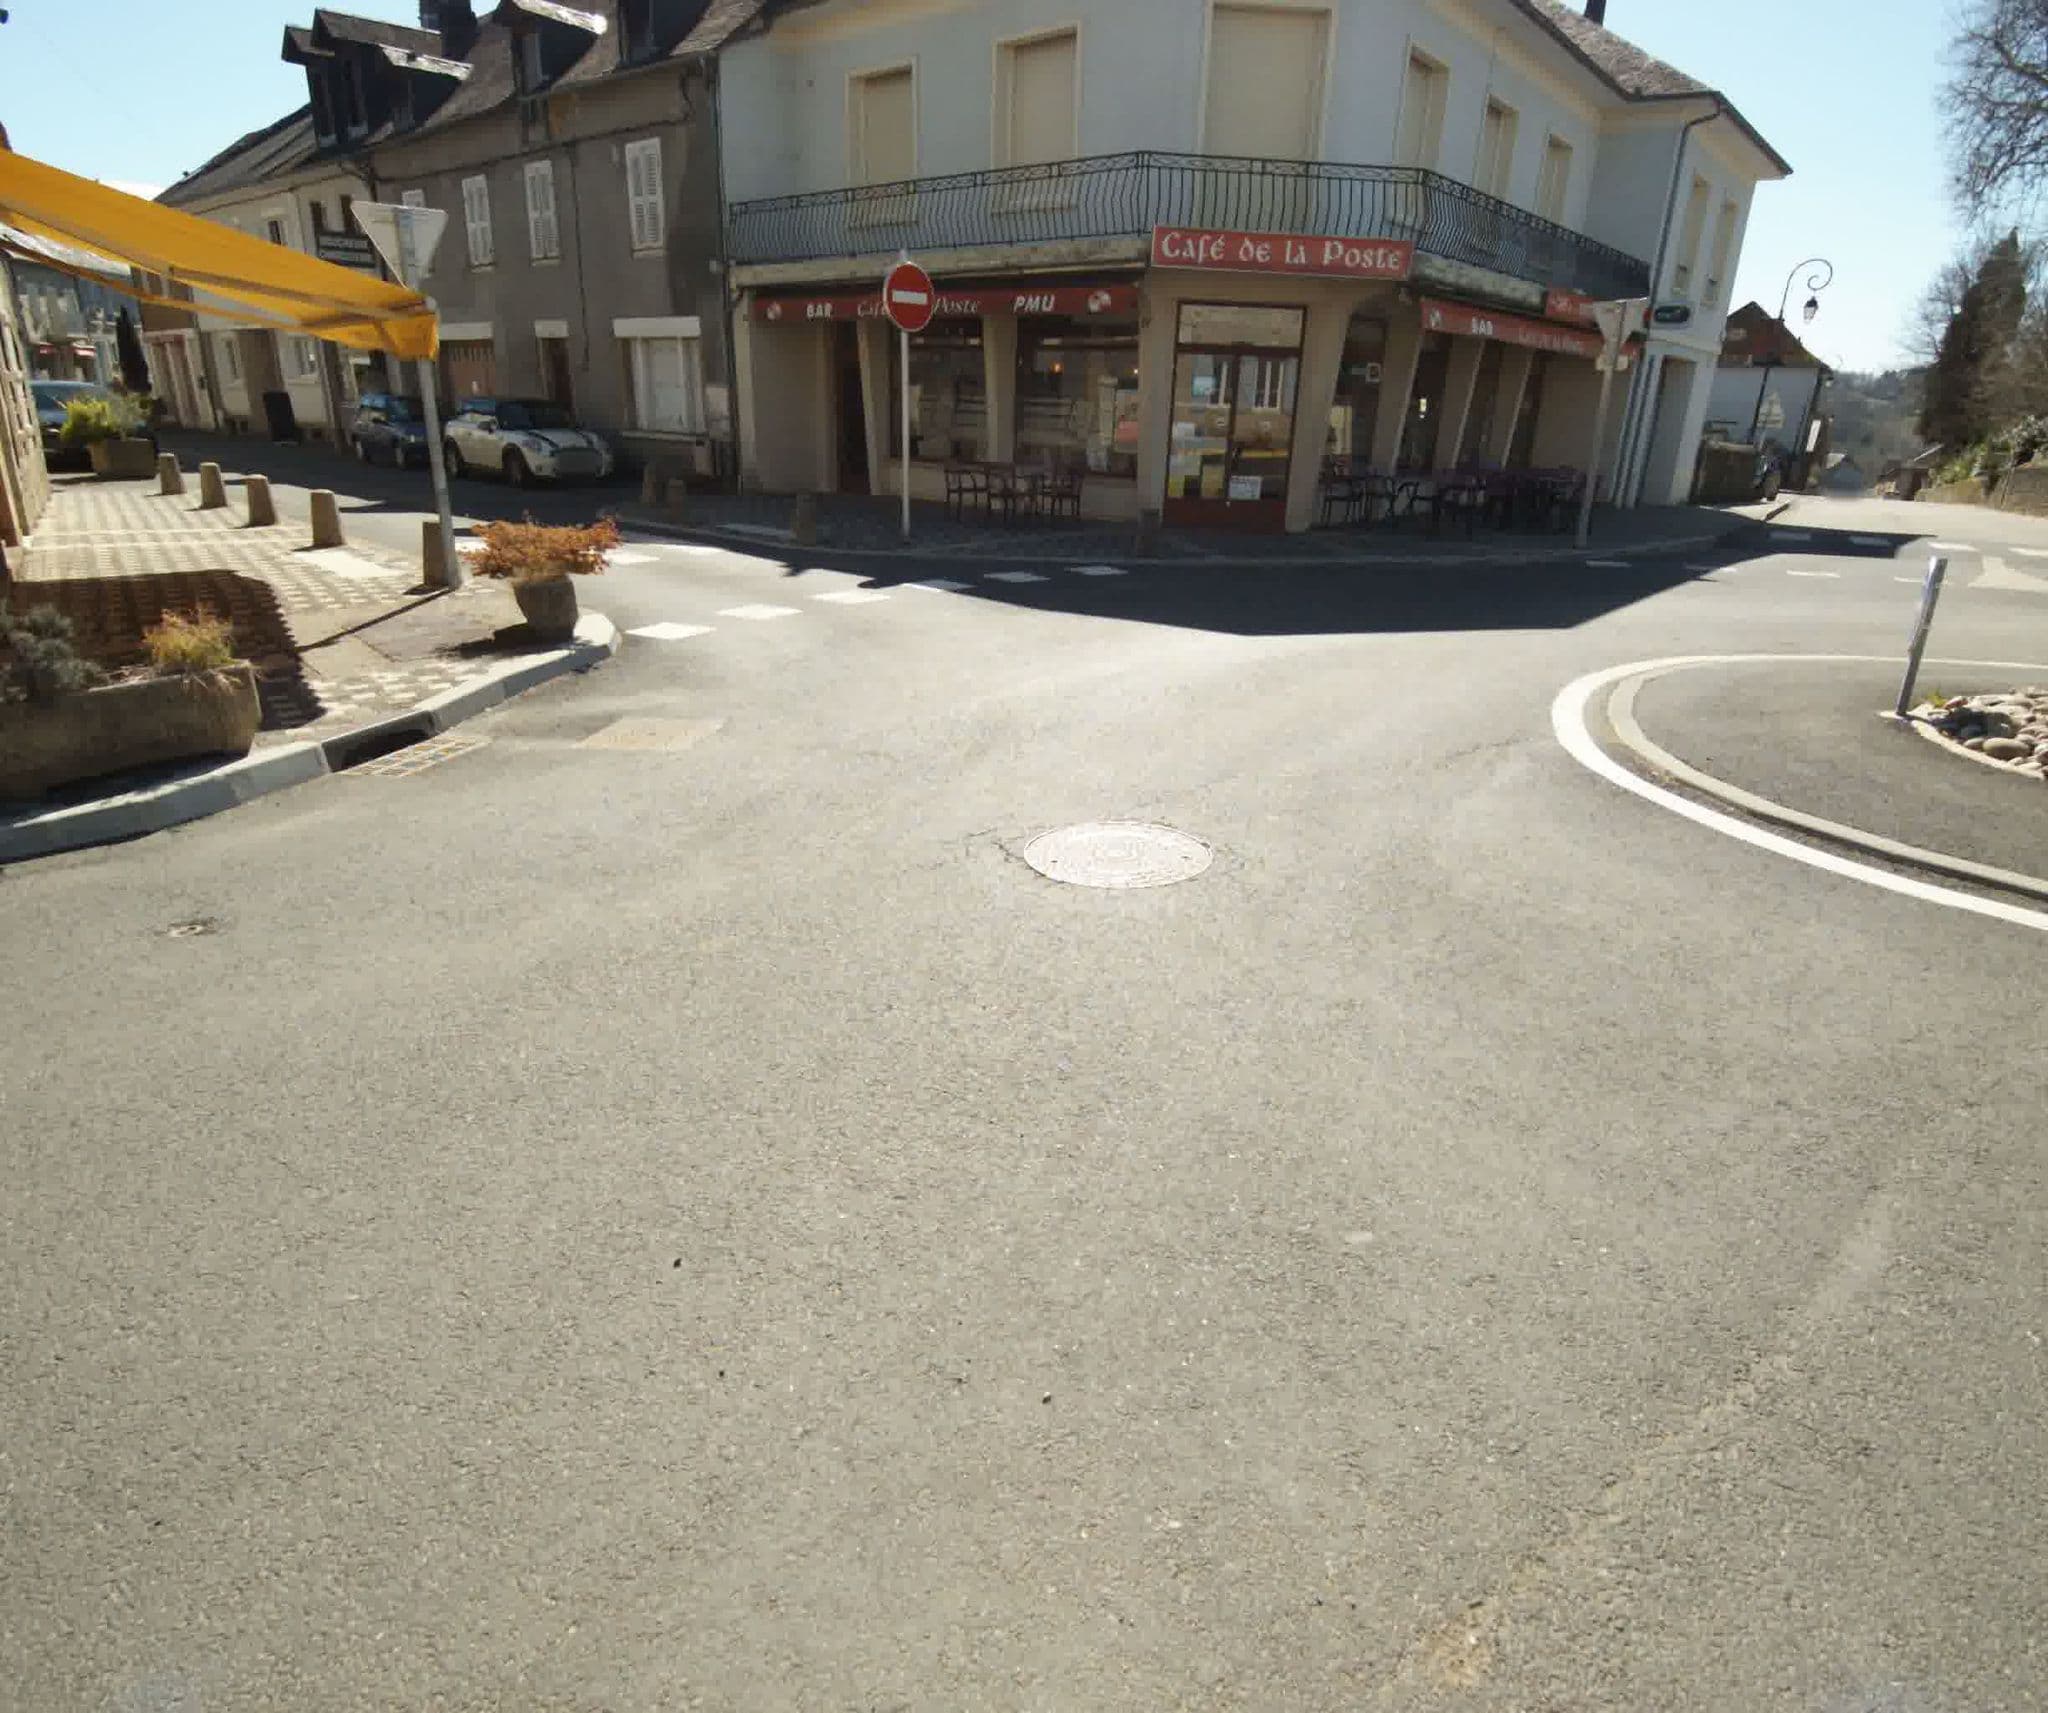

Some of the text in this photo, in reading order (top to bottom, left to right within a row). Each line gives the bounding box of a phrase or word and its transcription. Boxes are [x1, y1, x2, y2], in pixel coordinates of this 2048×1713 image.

[1161, 231, 1404, 270] Café de la Poste
[806, 302, 834, 319] BAR
[1012, 293, 1056, 313] PMU
